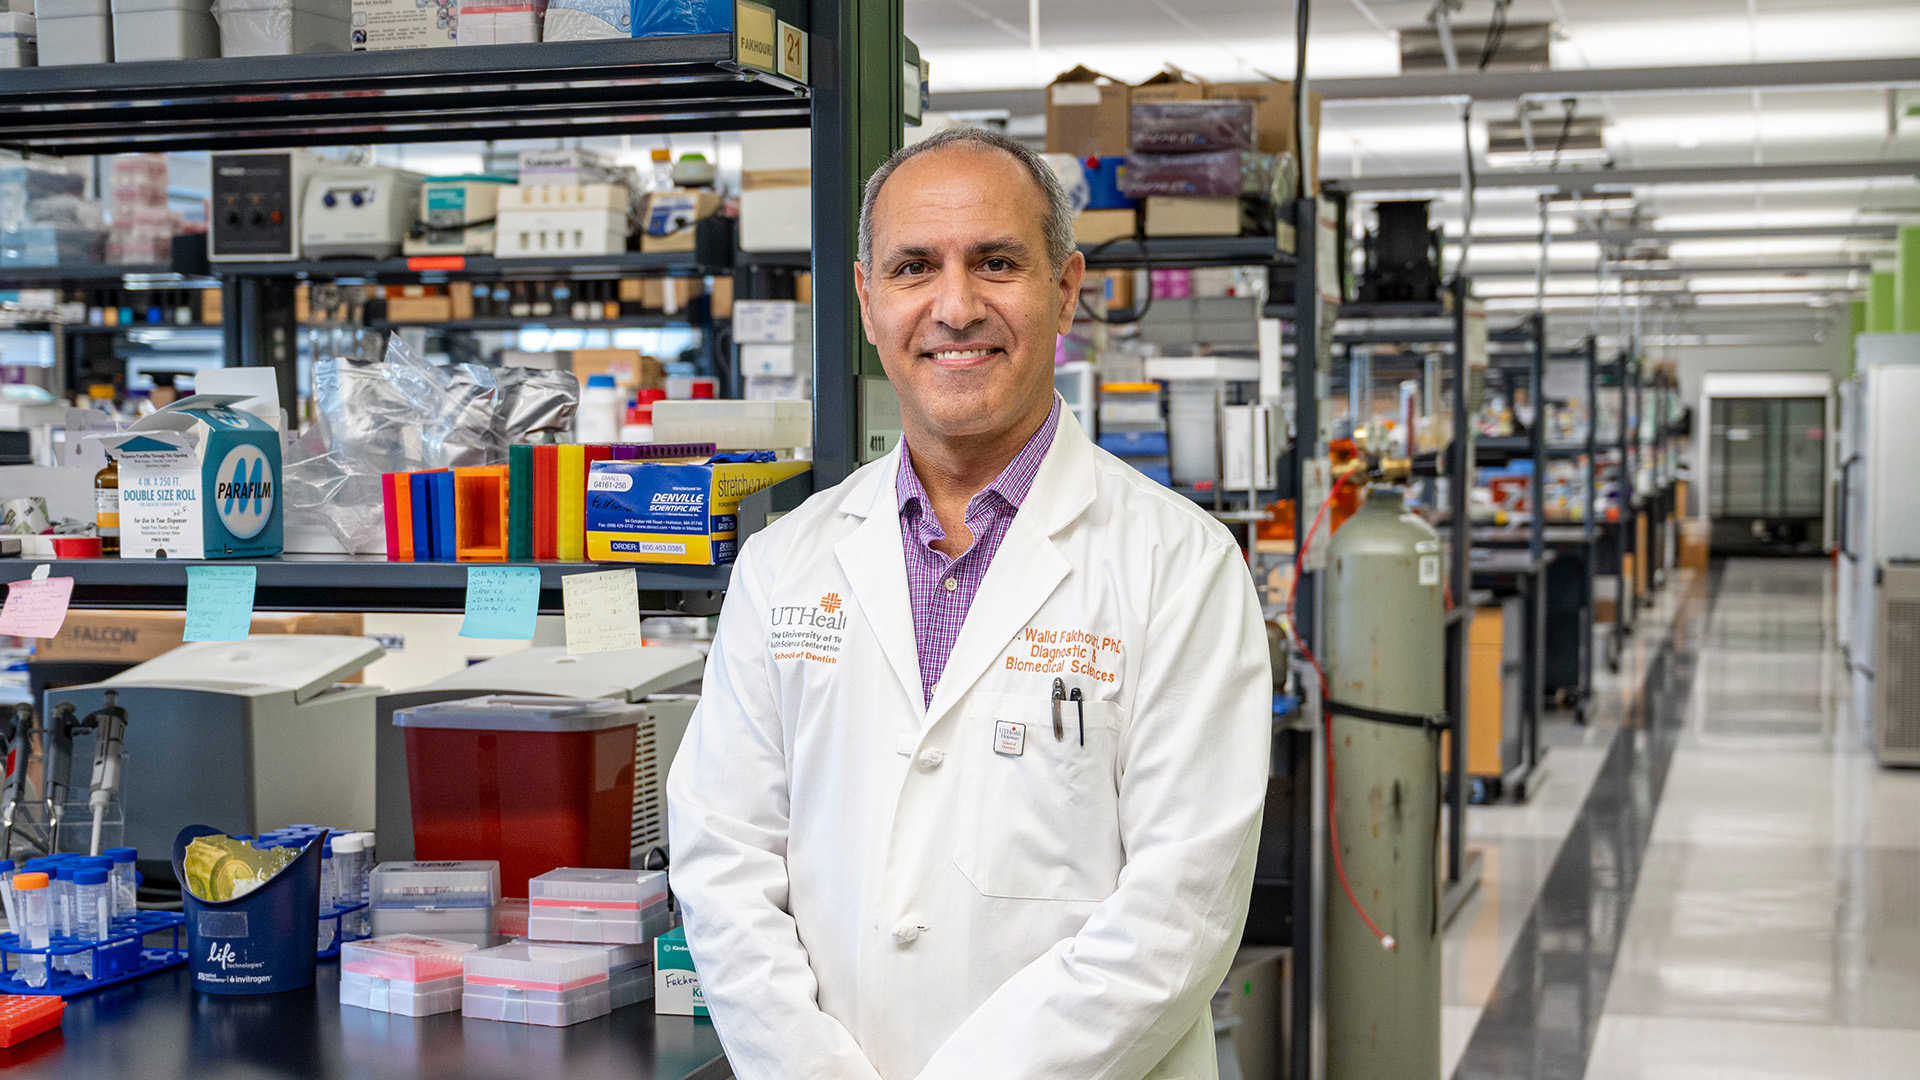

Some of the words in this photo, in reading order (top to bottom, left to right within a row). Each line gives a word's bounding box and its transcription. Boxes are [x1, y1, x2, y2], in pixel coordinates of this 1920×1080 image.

[787, 33, 800, 66] 21
[870, 435, 885, 452] 4111
[154, 478, 158, 486] X
[160, 477, 171, 487] 250
[173, 477, 181, 487] FT.
[594, 481, 626, 489] G4161-250
[124, 489, 154, 501] DOUBLE
[157, 489, 174, 501] SIZE
[176, 489, 196, 500] ROLL
[217, 482, 272, 500] PARAFILM
[652, 493, 704, 503] DENVILLE
[642, 544, 683, 552] 800.453.0385
[73, 626, 138, 642] FALCON
[771, 631, 781, 639] The
[782, 630, 821, 642] University
[1025, 628, 1057, 644] Walid
[775, 652, 795, 660] School
[1031, 644, 1087, 662] Diagnostic
[1006, 655, 1064, 674] Biomedical
[1070, 659, 1115, 683] Sciences
[207, 942, 236, 970] life
[236, 975, 271, 984] invitrogen
